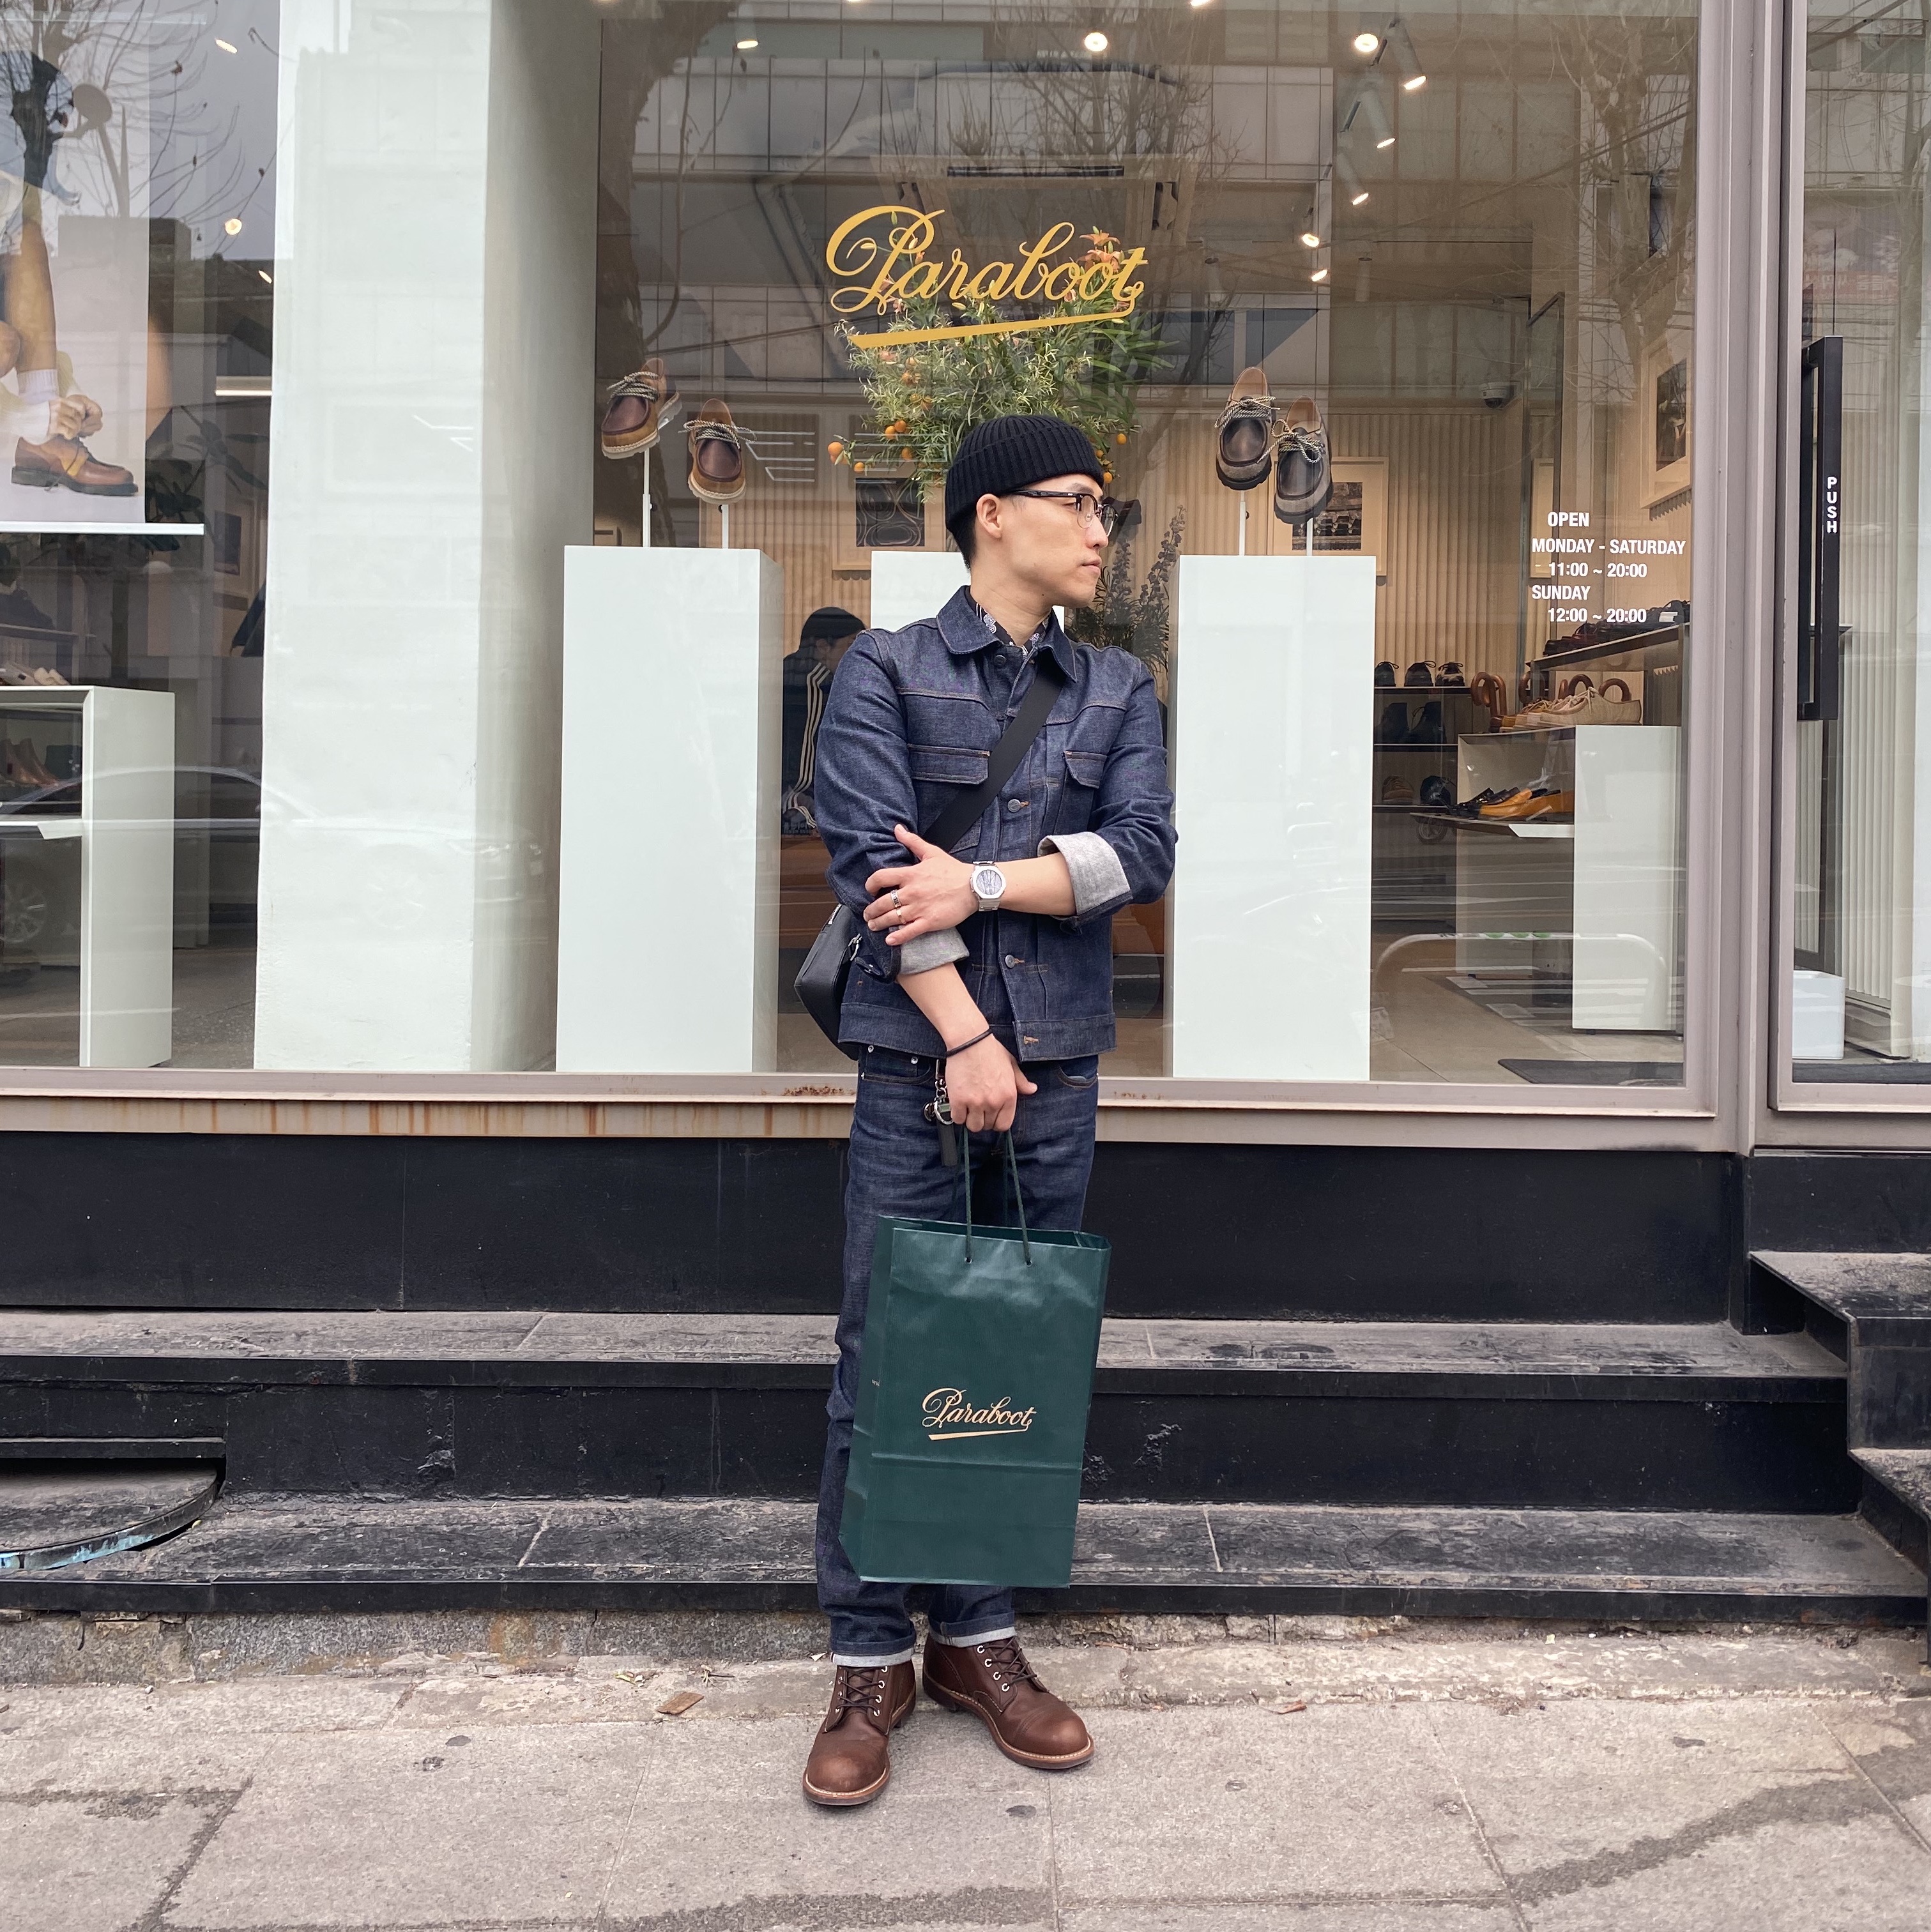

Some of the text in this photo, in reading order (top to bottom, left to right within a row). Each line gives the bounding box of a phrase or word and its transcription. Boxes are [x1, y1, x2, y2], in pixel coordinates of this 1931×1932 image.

[826, 205, 1149, 317] Paraboot
[1827, 476, 1837, 533] PUSH
[1547, 512, 1590, 527] OPEN
[1532, 538, 1595, 553] MONDAY
[1610, 539, 1686, 555] SATURDAY
[1548, 562, 1589, 577] 11:00
[1607, 563, 1647, 578] 20:00
[1532, 584, 1591, 600] SUNDAY
[1548, 607, 1588, 622] 12:00
[1607, 608, 1647, 623] 20:00
[922, 1387, 1037, 1429] Paraboot
